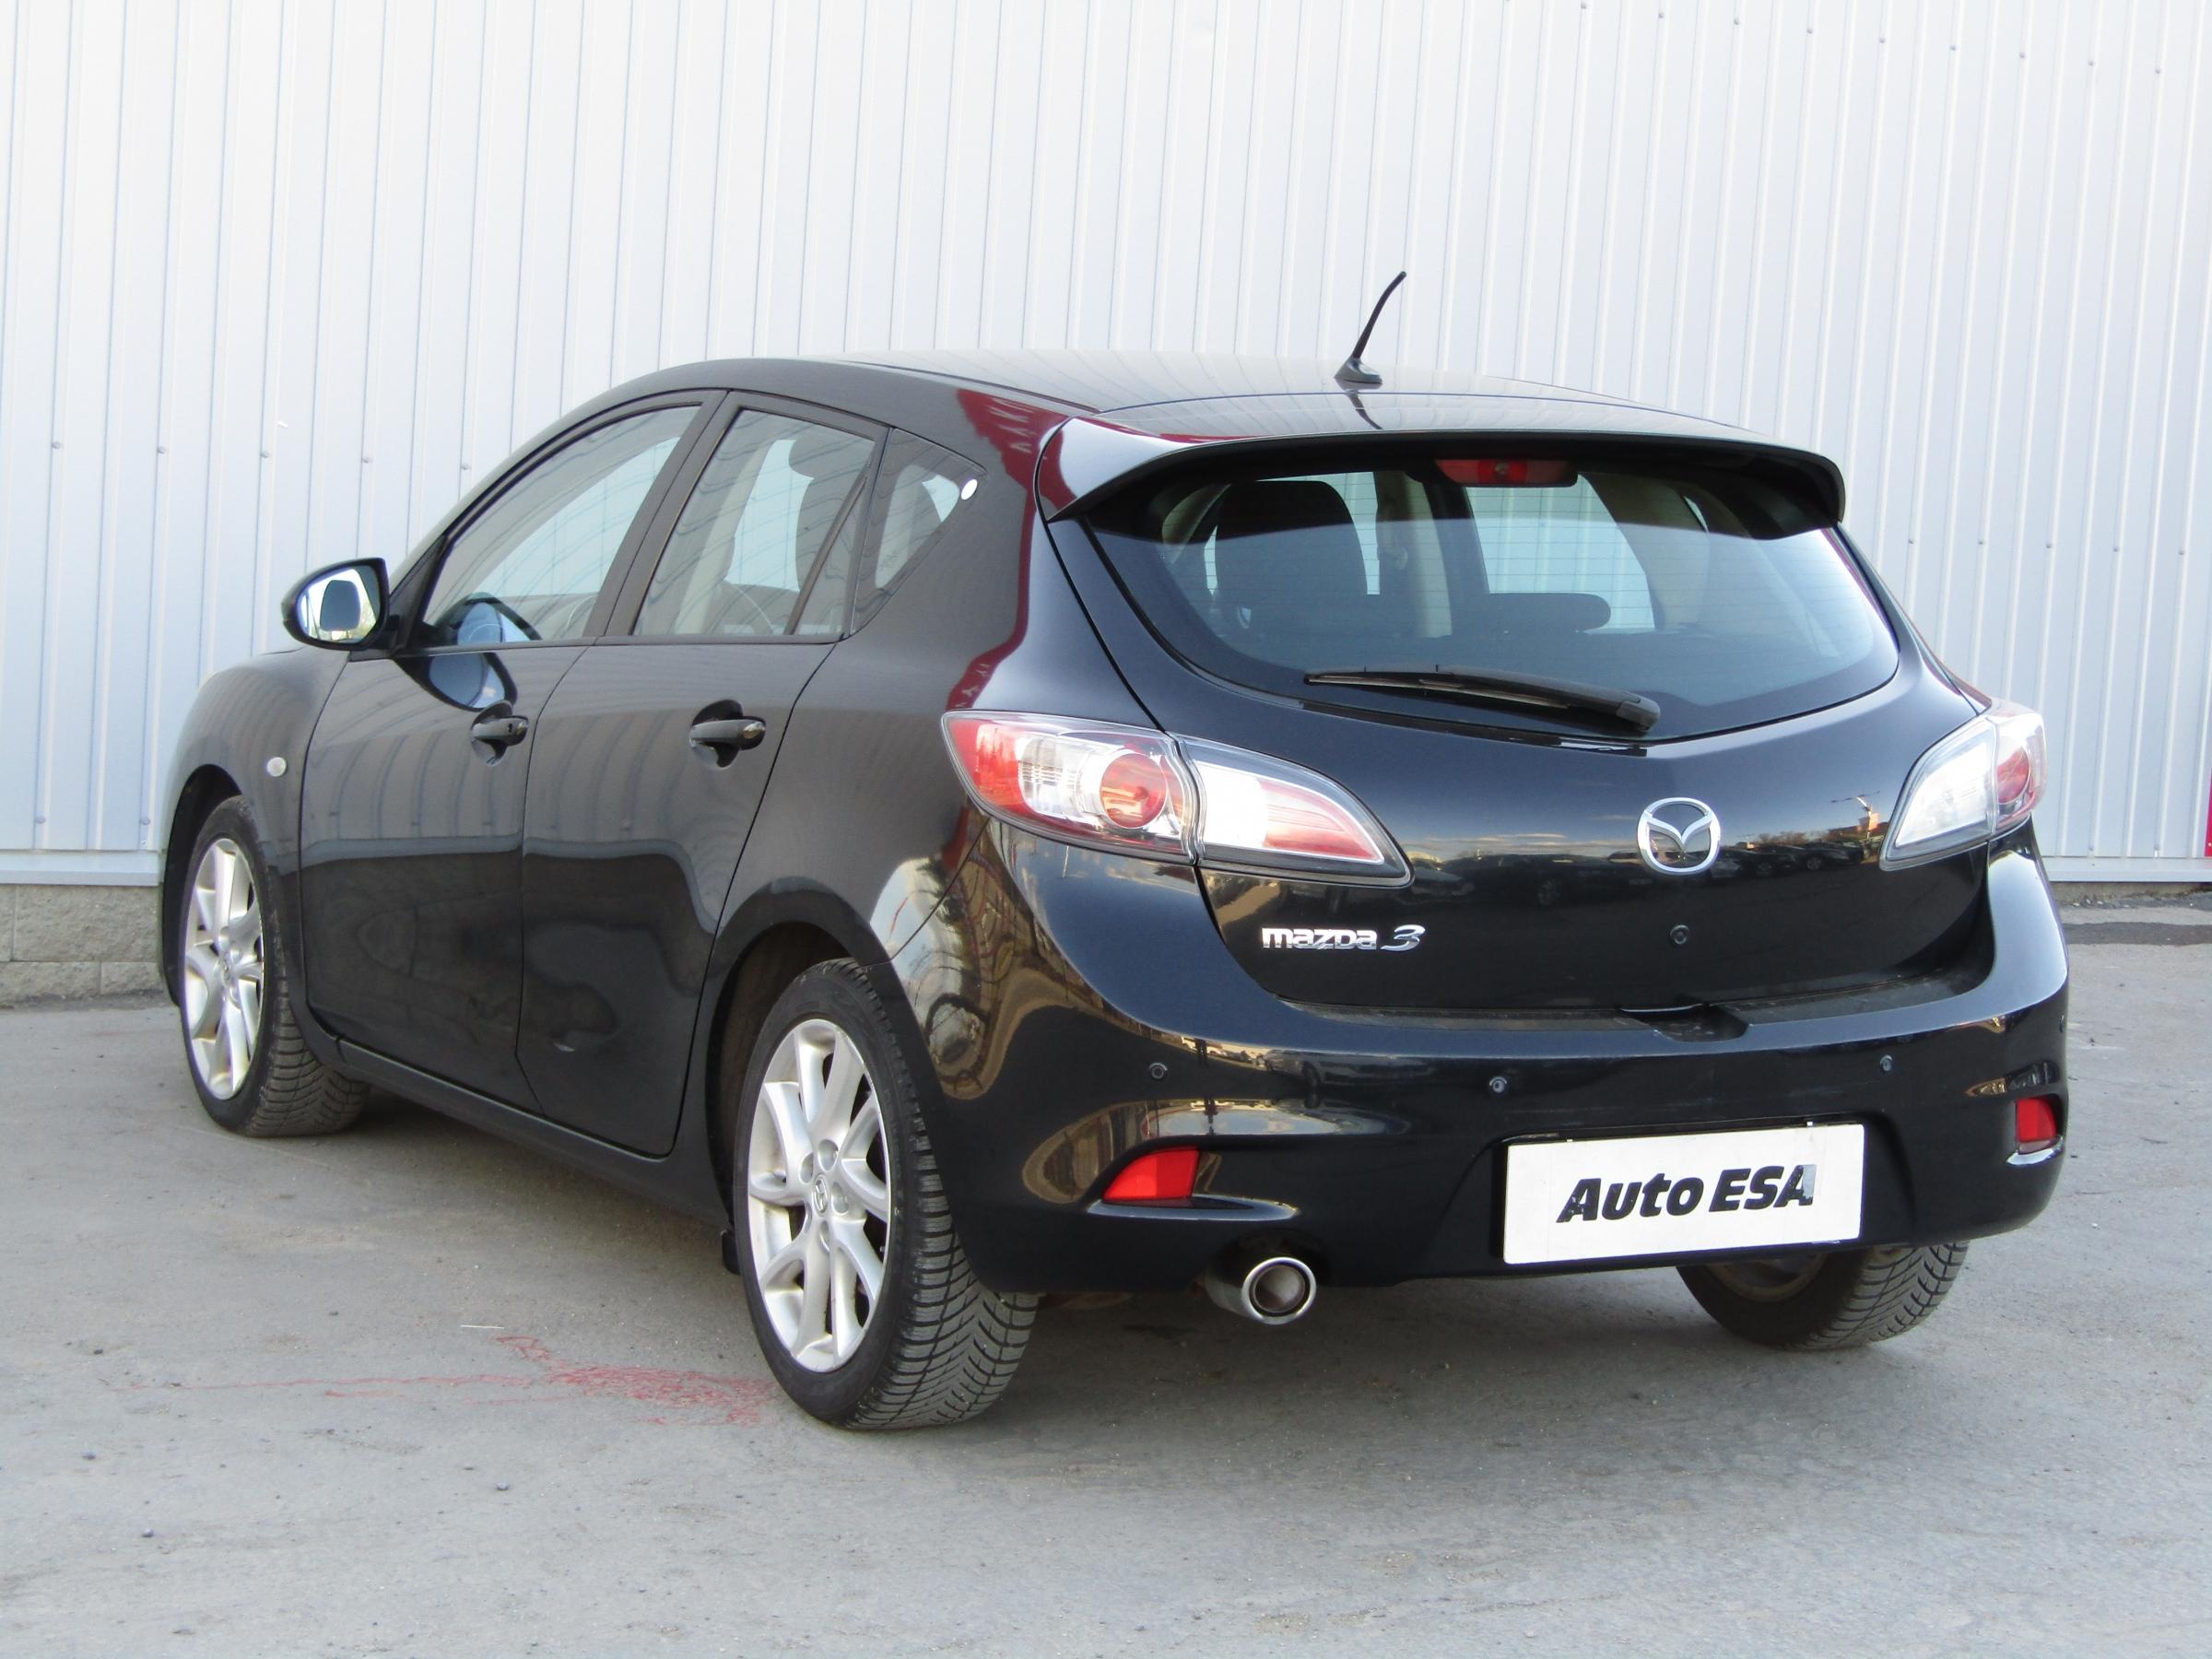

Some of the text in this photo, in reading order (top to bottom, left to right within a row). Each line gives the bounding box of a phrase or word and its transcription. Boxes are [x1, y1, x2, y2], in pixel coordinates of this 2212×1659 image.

[1261, 924, 1426, 951] mazda 3
[1556, 1164, 1816, 1223] Auto ESA
